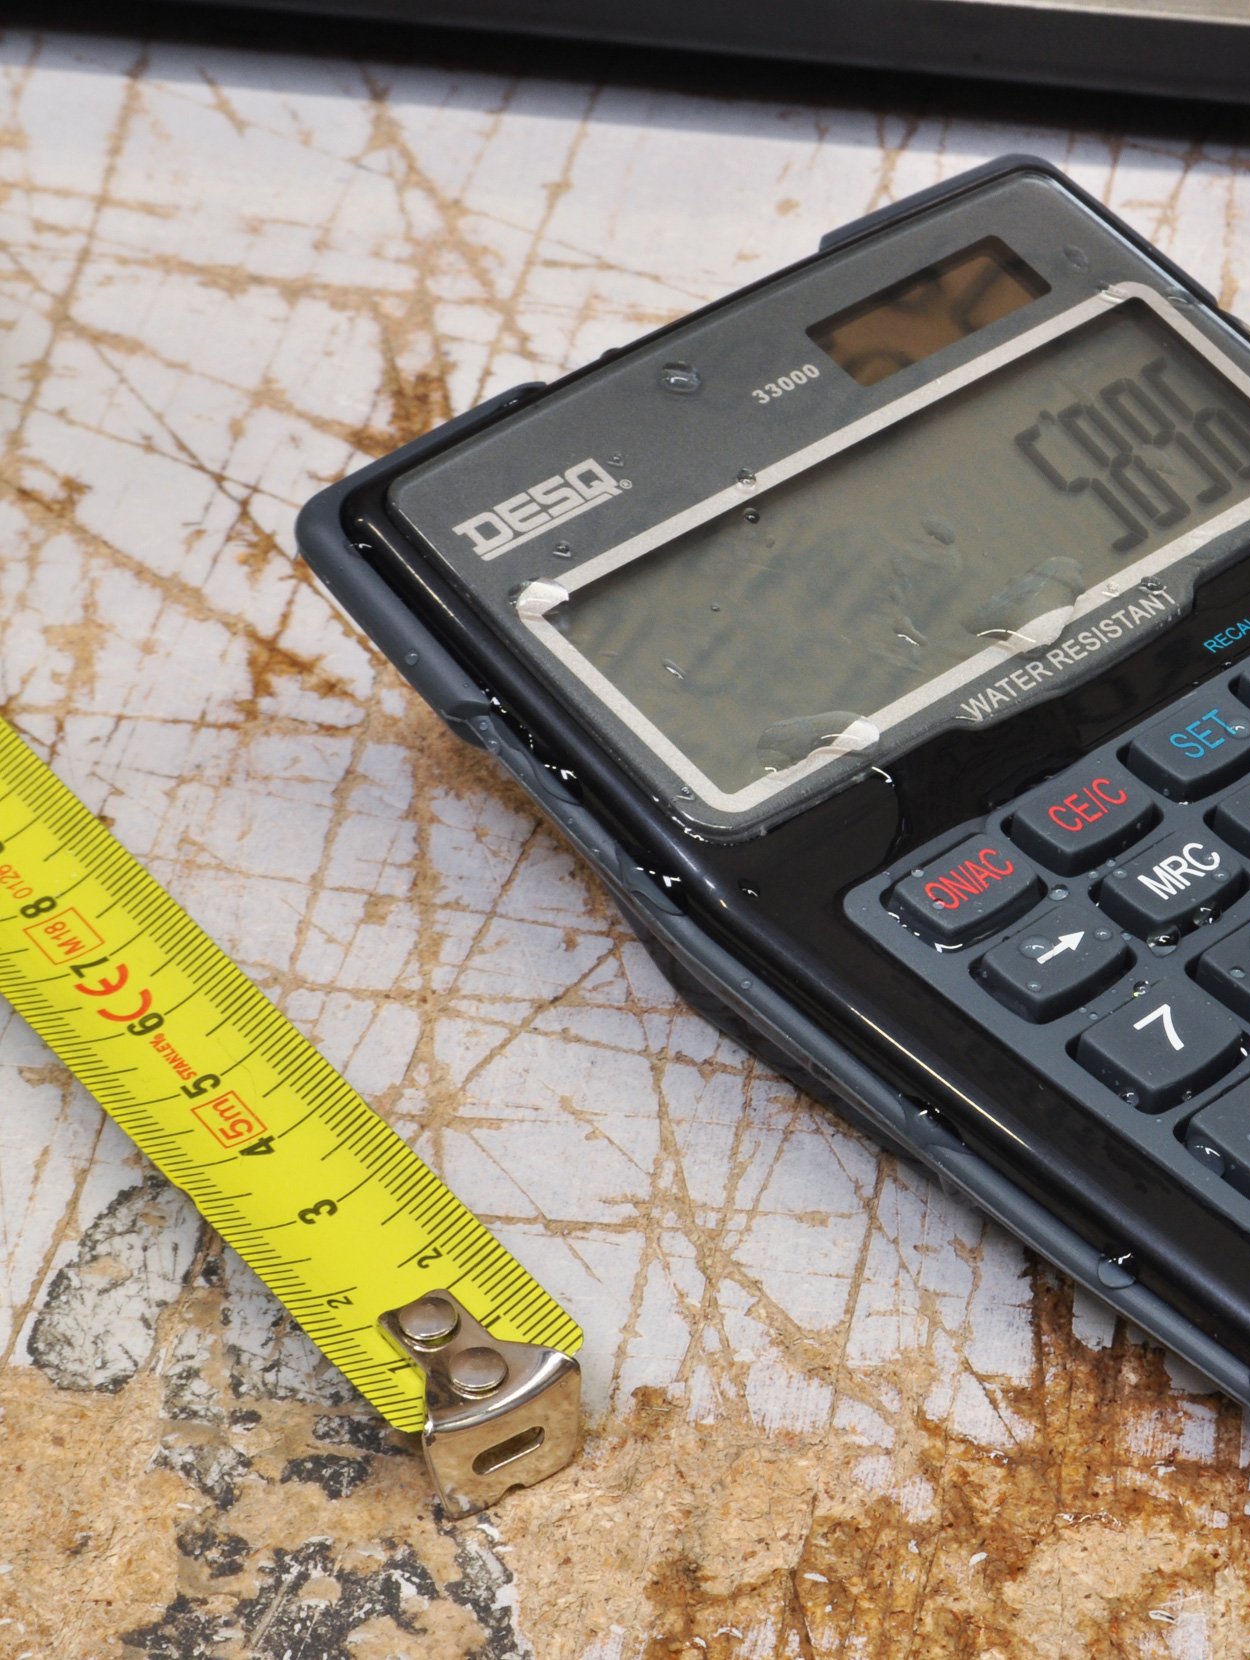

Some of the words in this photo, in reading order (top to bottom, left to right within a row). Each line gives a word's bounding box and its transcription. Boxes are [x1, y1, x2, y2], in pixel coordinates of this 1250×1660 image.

[751, 363, 821, 404] 33000
[452, 457, 623, 560] DESQ
[959, 660, 1053, 722] WATER
[1046, 584, 1176, 671] RESISTANT
[1168, 708, 1238, 759] SET
[1048, 778, 1128, 833] CE/C
[924, 848, 1014, 910] ON/AC
[1137, 842, 1221, 900] MRC
[19, 895, 58, 919] 8
[43, 920, 86, 956] M18
[69, 956, 110, 979] 7
[127, 1012, 165, 1037] 6
[1133, 1003, 1185, 1051] 7
[180, 1073, 221, 1099] 5
[211, 1097, 254, 1141] 5m
[238, 1135, 276, 1157] 4
[297, 1198, 338, 1225] 3
[416, 1246, 443, 1269] 2
[326, 1295, 354, 1309] 2
